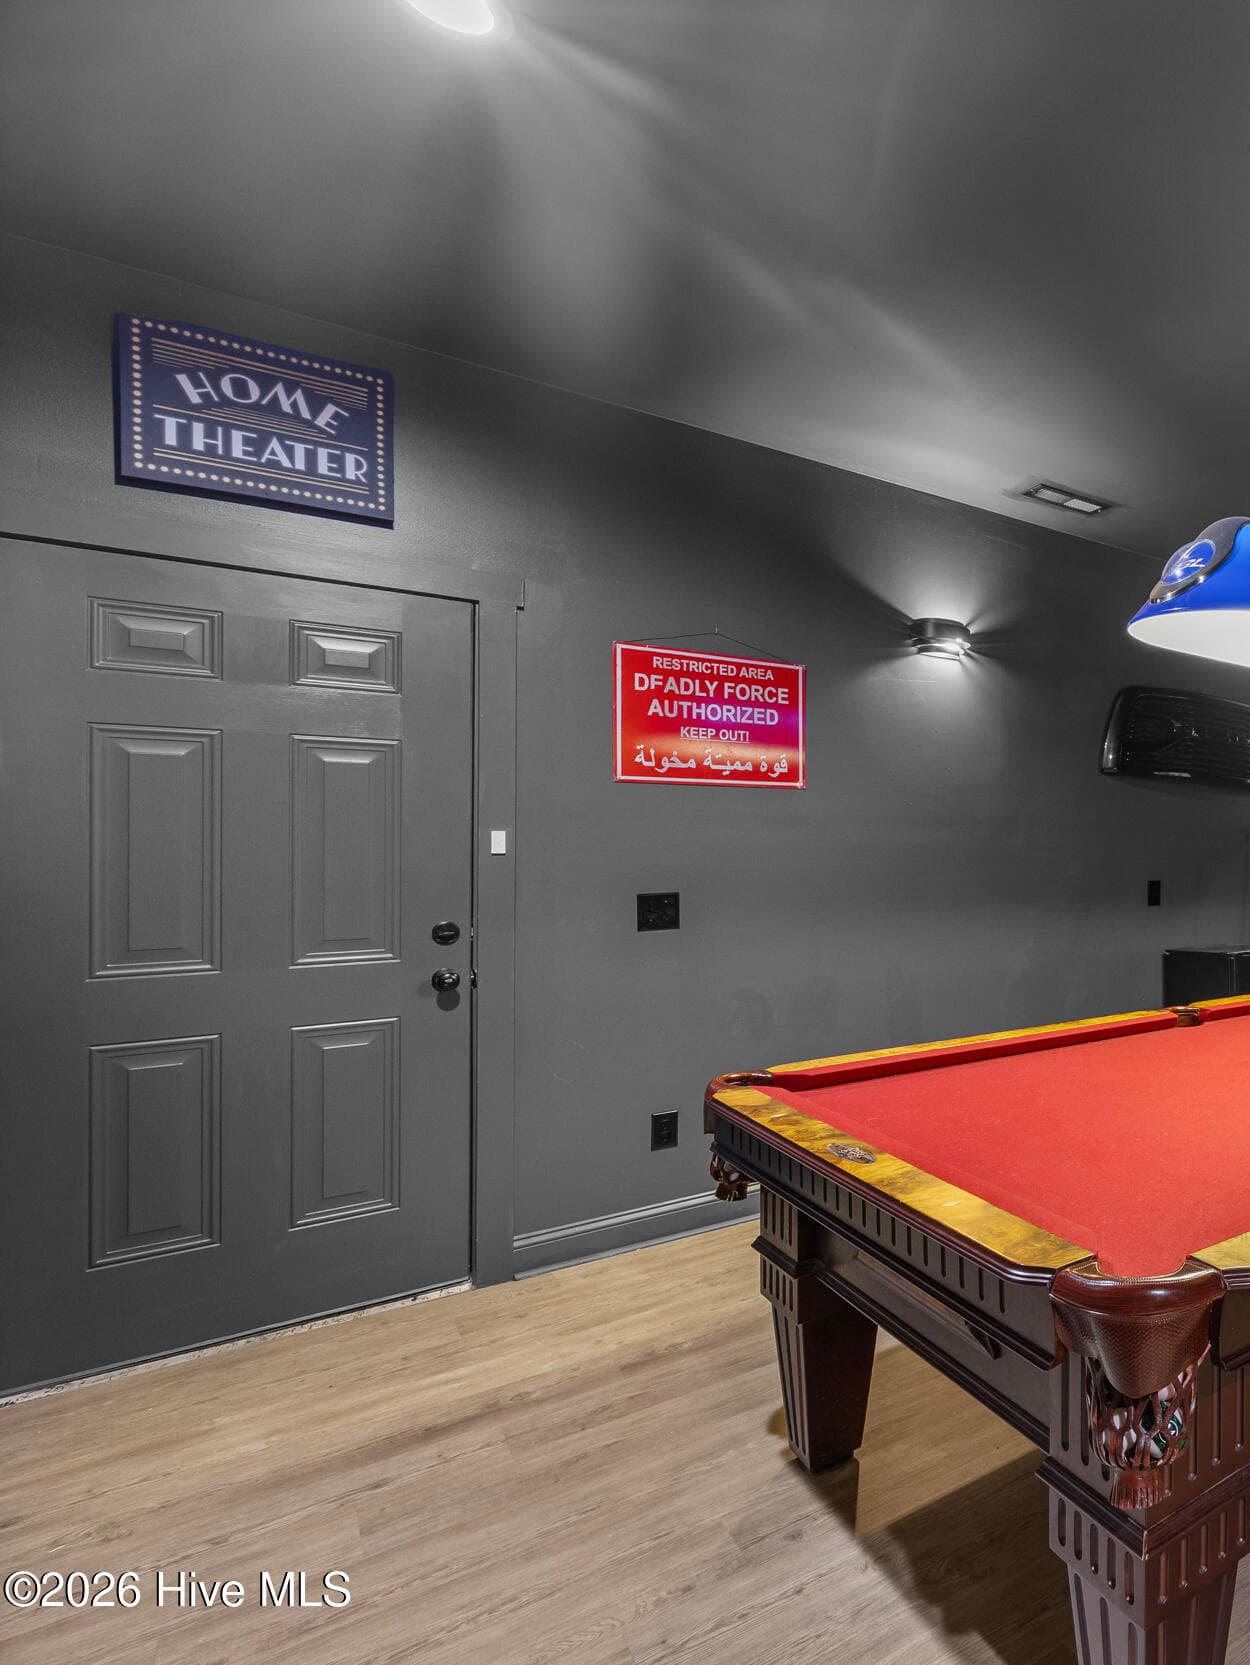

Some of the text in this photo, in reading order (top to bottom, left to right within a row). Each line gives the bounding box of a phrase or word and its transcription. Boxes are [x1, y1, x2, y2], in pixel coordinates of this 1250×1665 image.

[175, 372, 349, 434] HOME
[154, 414, 367, 483] THEATER
[652, 656, 774, 681] RESTRICTED AREA
[723, 682, 789, 705] FORCE
[647, 698, 779, 726] AUTHORIZED
[680, 726, 750, 742] KEEP OUT!
[634, 744, 697, 773] مخولة
[760, 753, 789, 778] قوة
